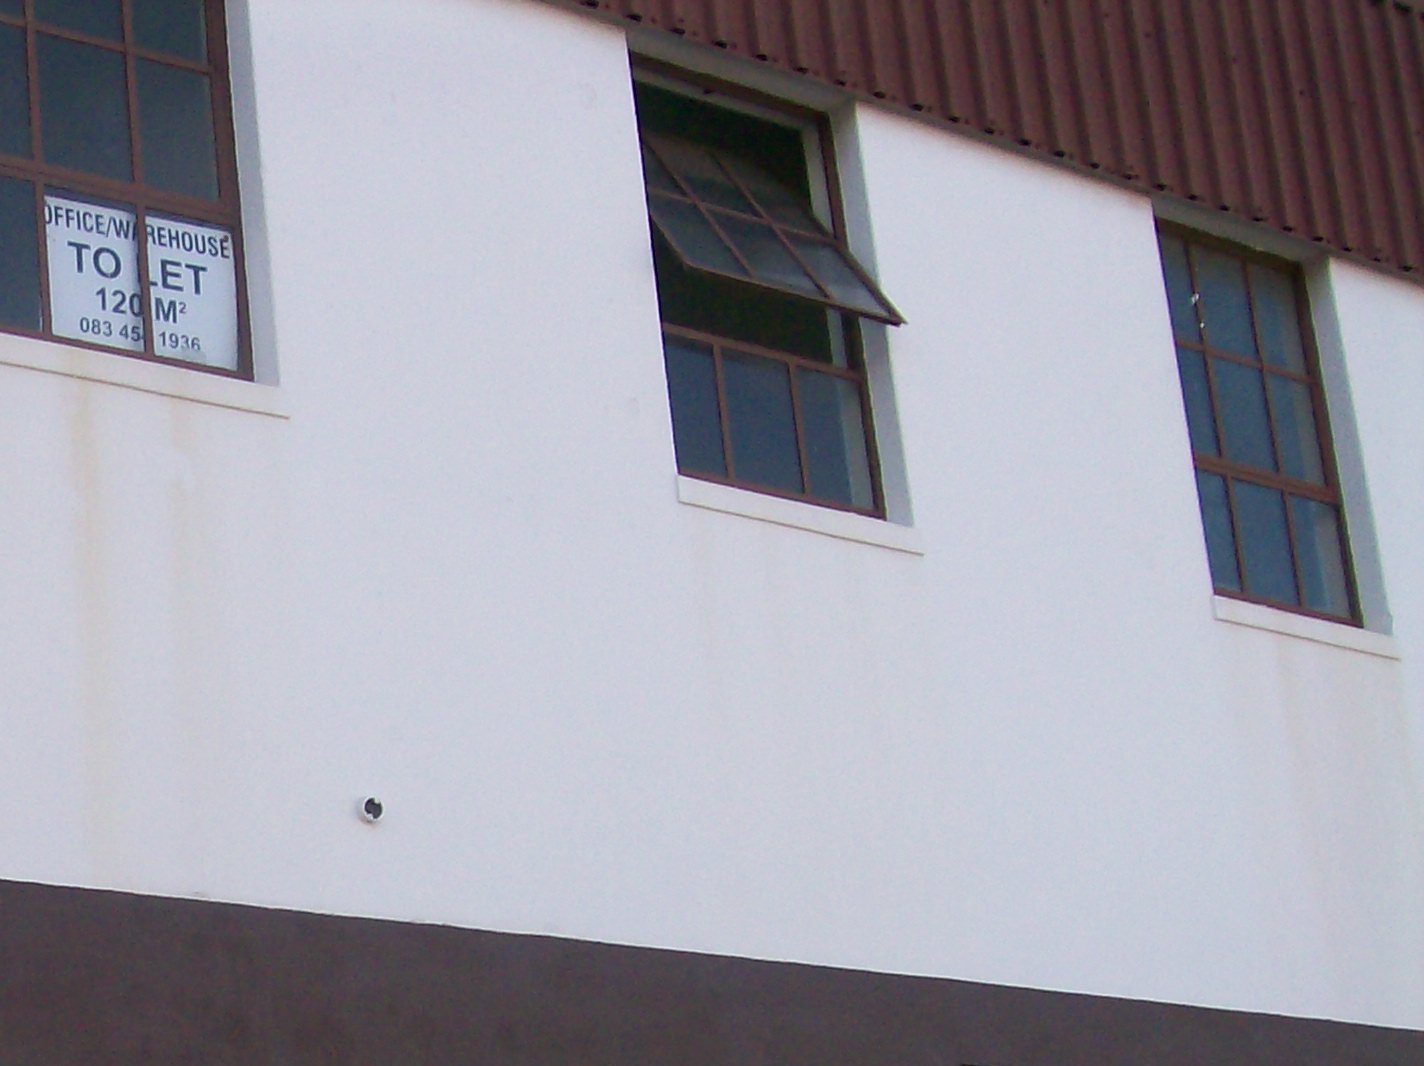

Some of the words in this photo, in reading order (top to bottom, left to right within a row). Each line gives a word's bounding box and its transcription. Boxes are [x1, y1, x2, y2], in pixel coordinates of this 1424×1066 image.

[67, 241, 122, 279] TO
[95, 287, 144, 318] 120
[79, 317, 113, 337] 083
[119, 324, 145, 343] 45
[158, 331, 201, 352] 1936
